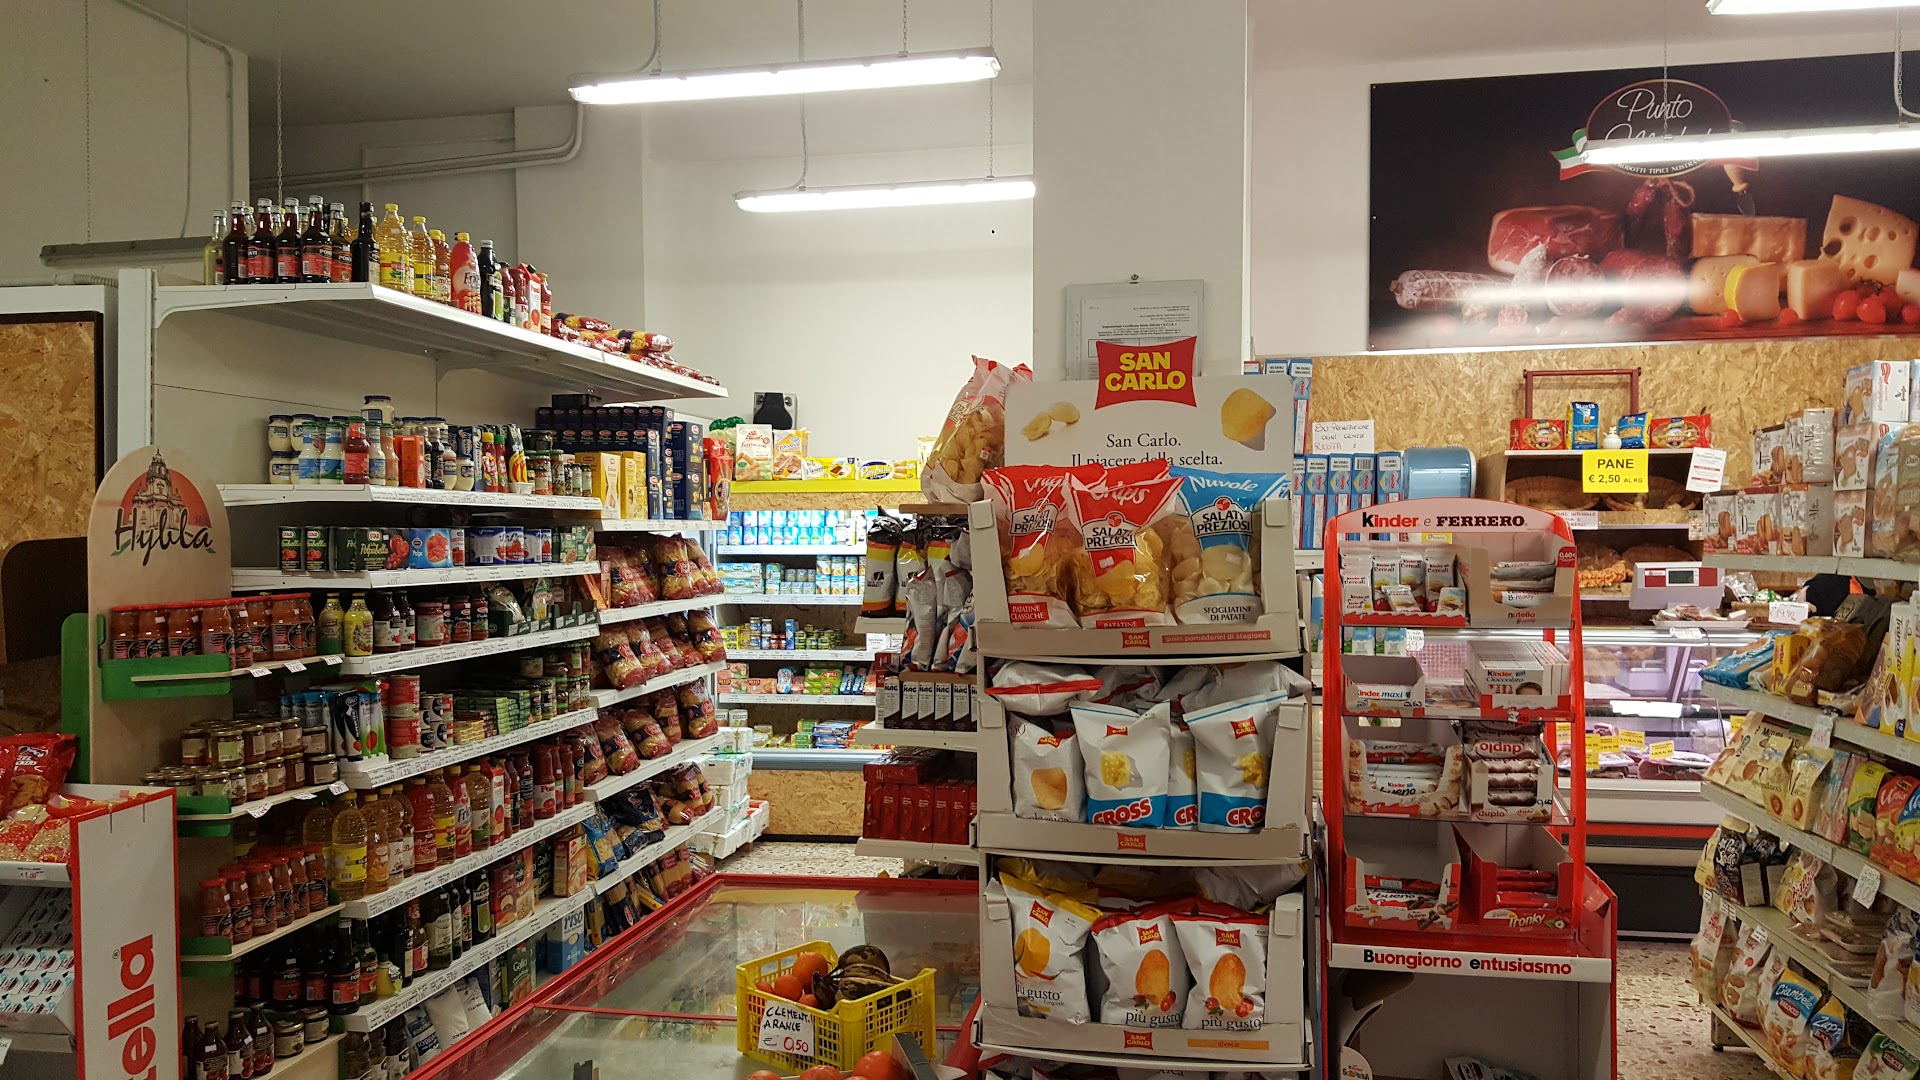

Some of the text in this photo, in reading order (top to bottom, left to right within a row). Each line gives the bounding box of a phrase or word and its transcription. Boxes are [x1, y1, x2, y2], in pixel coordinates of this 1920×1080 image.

[1616, 88, 1693, 122] Punto
[1649, 166, 1669, 174] TIPICI
[1671, 160, 1703, 172] NOSTRA
[1118, 351, 1171, 372] SAN
[1104, 371, 1187, 392] CARLO
[1106, 432, 1182, 448] San Carlo.
[1071, 453, 1082, 467] Il
[1086, 454, 1136, 468] piacere
[1178, 452, 1223, 466] scelta.
[1597, 458, 1634, 469] PANE
[1189, 475, 1259, 492] Nuvole
[1588, 474, 1596, 483] €
[1598, 474, 1621, 484] 2,50
[1202, 511, 1243, 524] SALATI
[1362, 511, 1525, 528] Kinder e FERRERO
[1196, 520, 1251, 533] PREZIOSI
[369, 532, 381, 541] STAR
[1012, 604, 1040, 614] PATATINE
[1203, 606, 1252, 615] SFOGLIATINE
[1103, 620, 1138, 628] PATATINE
[1210, 613, 1246, 622] DI PATATE
[1124, 638, 1148, 646] CARLO
[1381, 690, 1404, 699] maxi
[1479, 742, 1525, 753] duplo
[1091, 798, 1152, 825] CROSS
[1228, 805, 1265, 827] CRO
[1478, 808, 1507, 818] duplo
[1508, 912, 1545, 928] Tronky
[1363, 949, 1572, 975] Buongiorno entusiasmo
[1027, 988, 1060, 1003] gusto
[762, 1019, 801, 1032] ARANCE
[1125, 1010, 1181, 1028] più gusto
[1201, 1016, 1262, 1031] più gusto
[1126, 1038, 1151, 1047] CARLO
